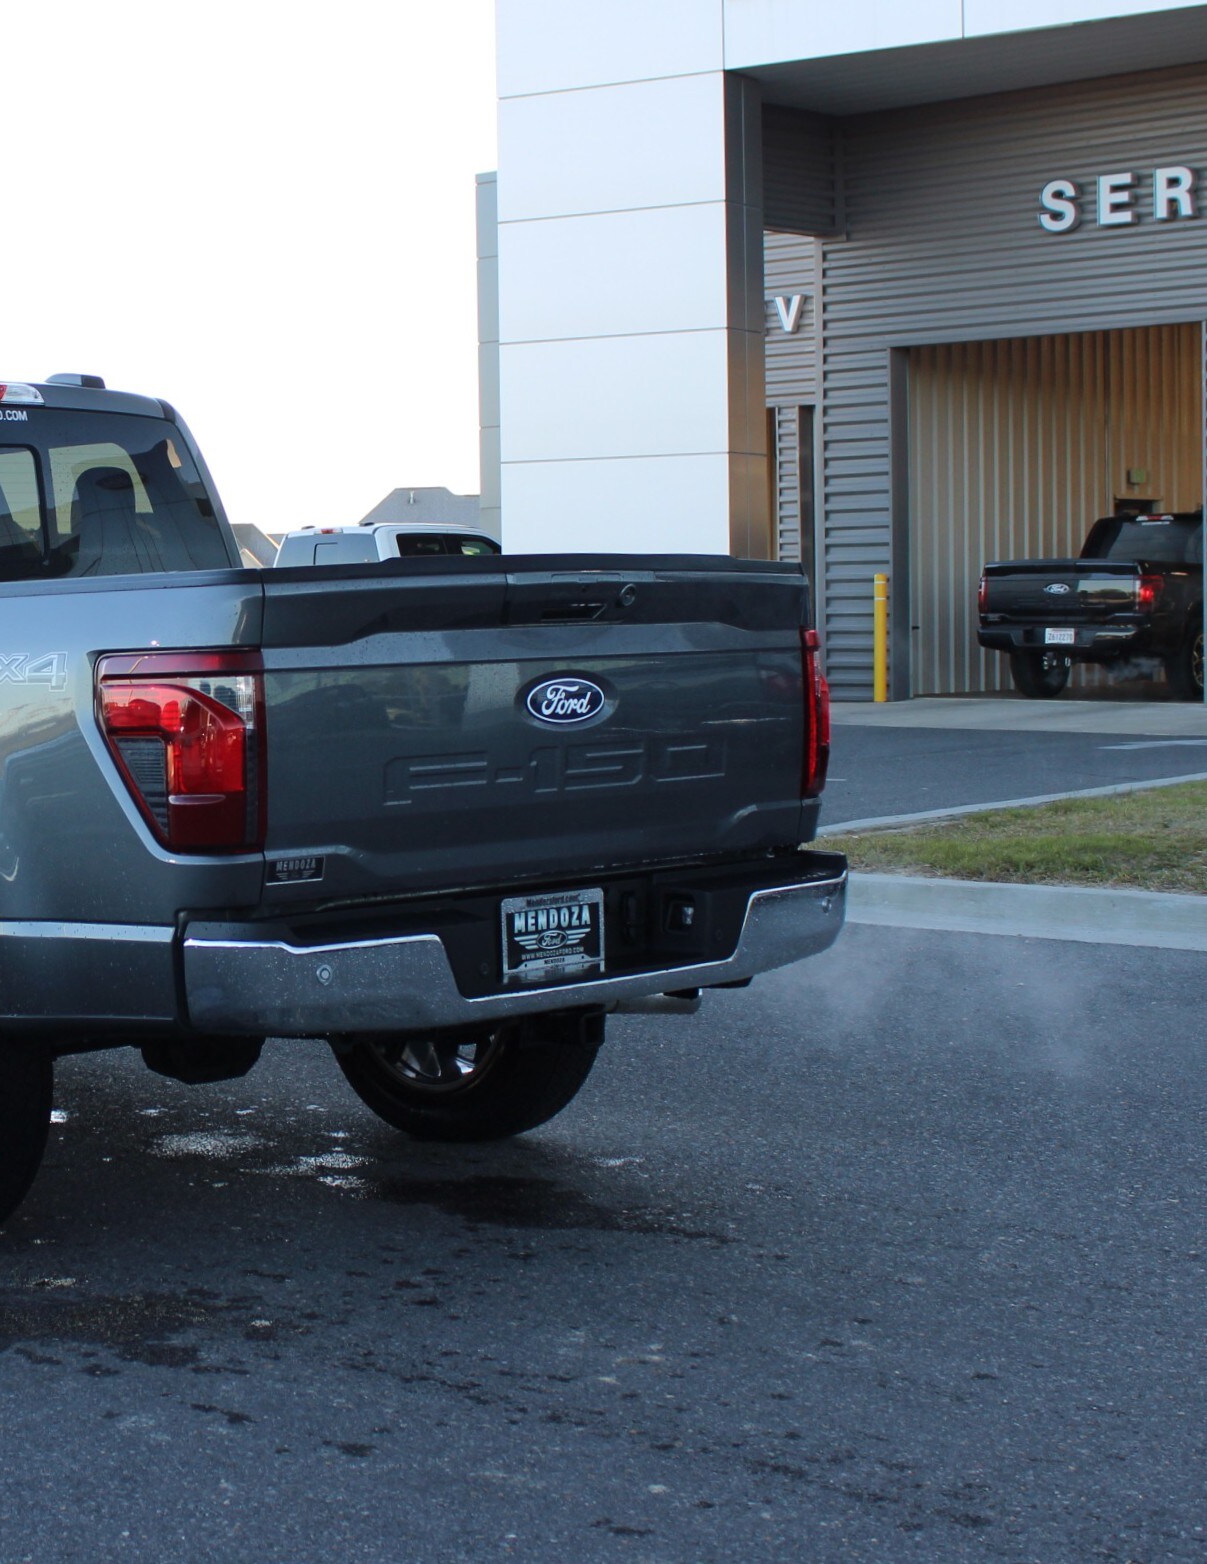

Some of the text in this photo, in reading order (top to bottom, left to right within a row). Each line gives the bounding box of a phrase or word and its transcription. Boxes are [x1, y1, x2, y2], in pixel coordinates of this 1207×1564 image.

[1037, 164, 1197, 234] SER
[541, 684, 592, 716] Ford
[383, 738, 727, 805] F-150
[275, 858, 316, 872] MENDOZA
[514, 904, 591, 934] MENDOZA
